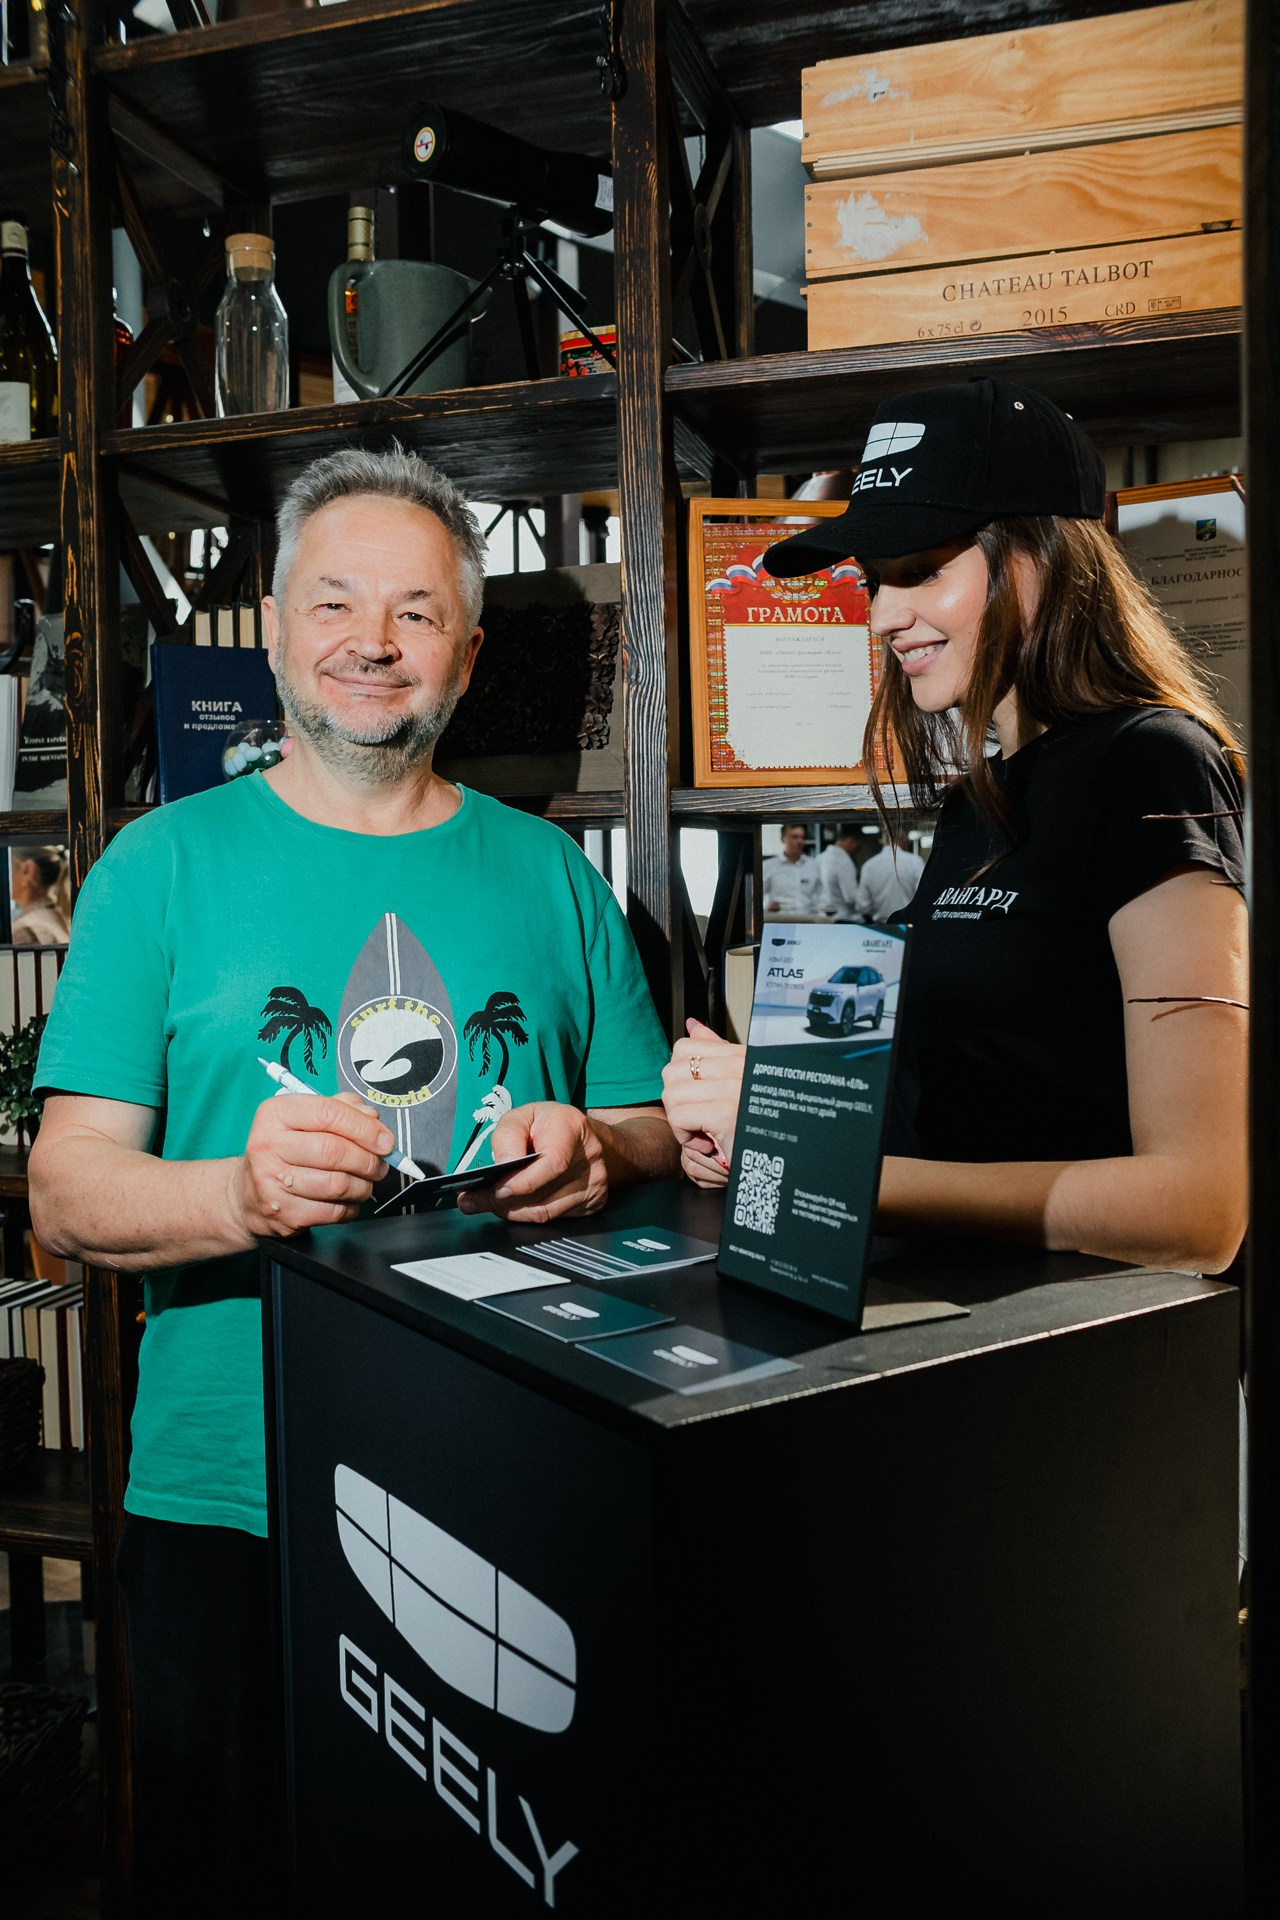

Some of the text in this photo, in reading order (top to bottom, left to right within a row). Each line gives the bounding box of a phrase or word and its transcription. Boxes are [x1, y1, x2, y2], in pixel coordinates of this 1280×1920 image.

[942, 260, 1154, 303] CHATEAU TALBOT
[1022, 306, 1068, 327] 2015
[1104, 301, 1136, 318] CRD
[917, 321, 964, 339] 6 x 75 cl
[747, 606, 846, 623] ГРАМОТА
[191, 700, 242, 713] КНИГА
[184, 722, 237, 732] и предложе
[199, 713, 236, 723] отзывов
[932, 886, 1019, 914] АВАНГАРД
[766, 967, 805, 979] ATLAS
[351, 997, 441, 1028] surf the
[753, 1063, 784, 1077] ДОРОГИЕ
[782, 1068, 806, 1080] ГОСТИ
[805, 1071, 846, 1087] РЕСТОРАНА
[367, 1085, 432, 1105] world
[339, 1633, 580, 1909] GEELY
